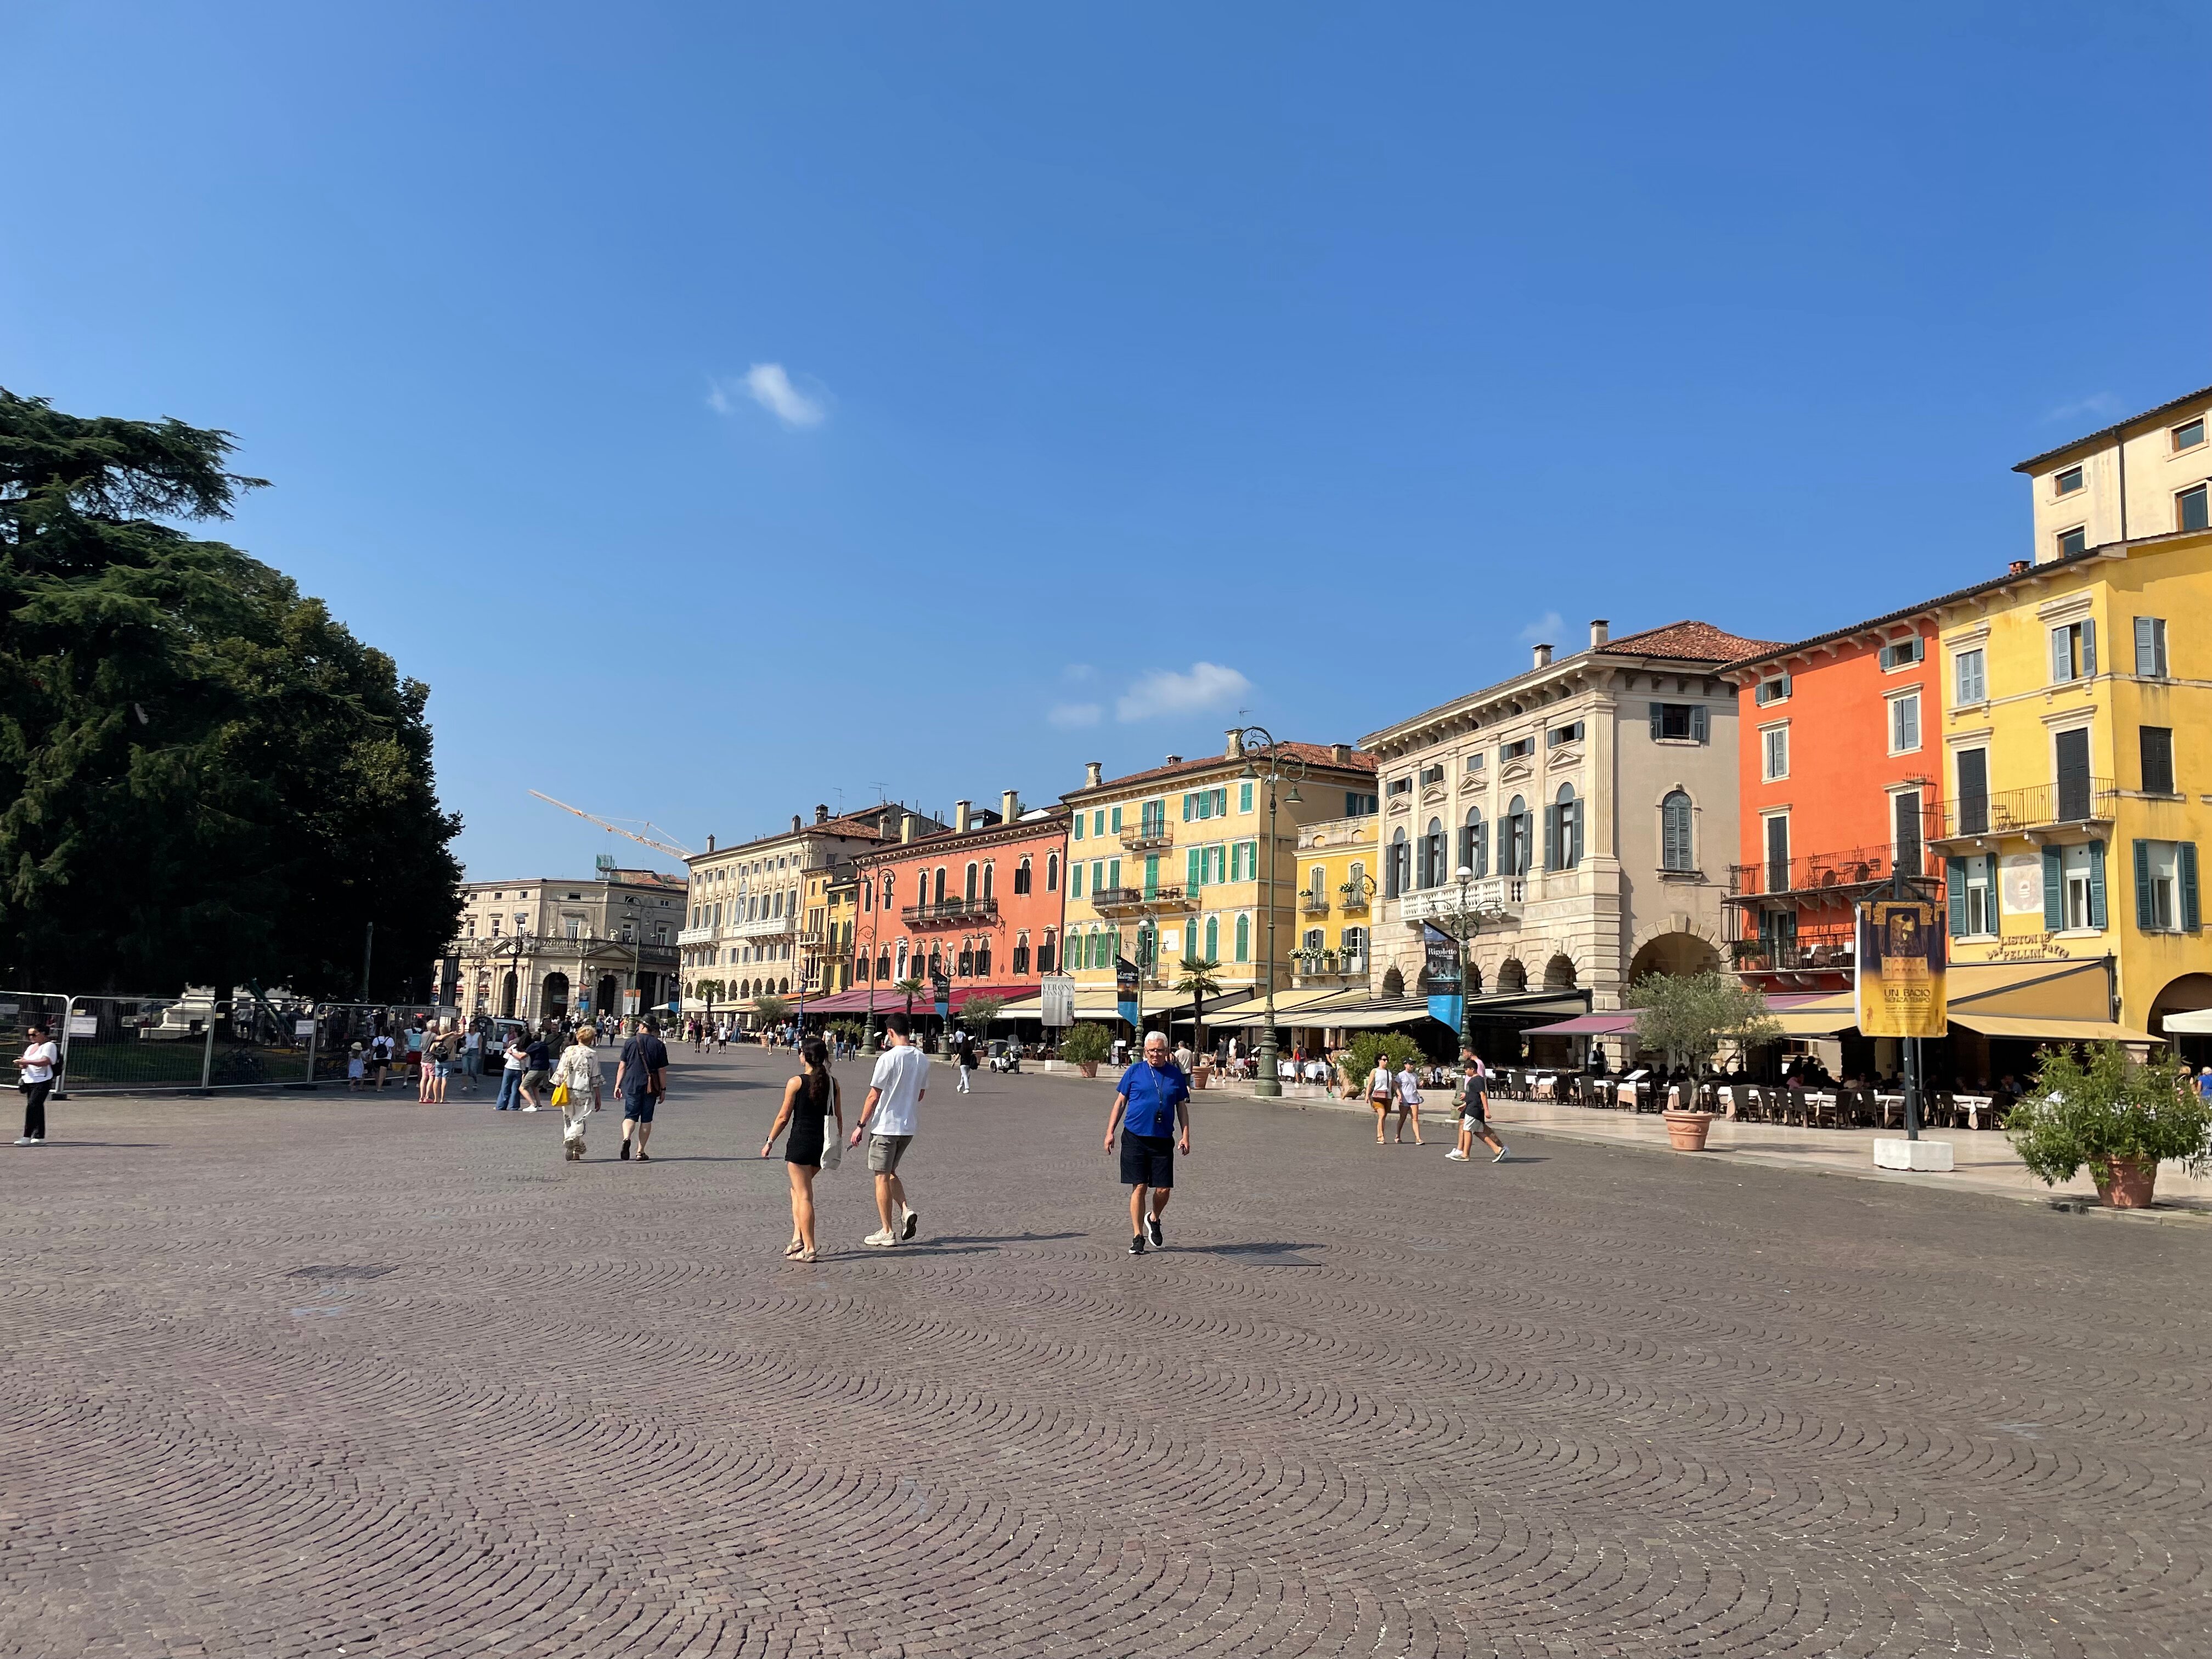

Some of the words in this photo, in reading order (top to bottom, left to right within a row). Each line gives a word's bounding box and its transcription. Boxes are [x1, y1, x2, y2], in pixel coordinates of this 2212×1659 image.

[2001, 934, 2038, 946] LISTON
[1428, 948, 1457, 957] Rigoletto
[2004, 949, 2045, 960] PELLINI
